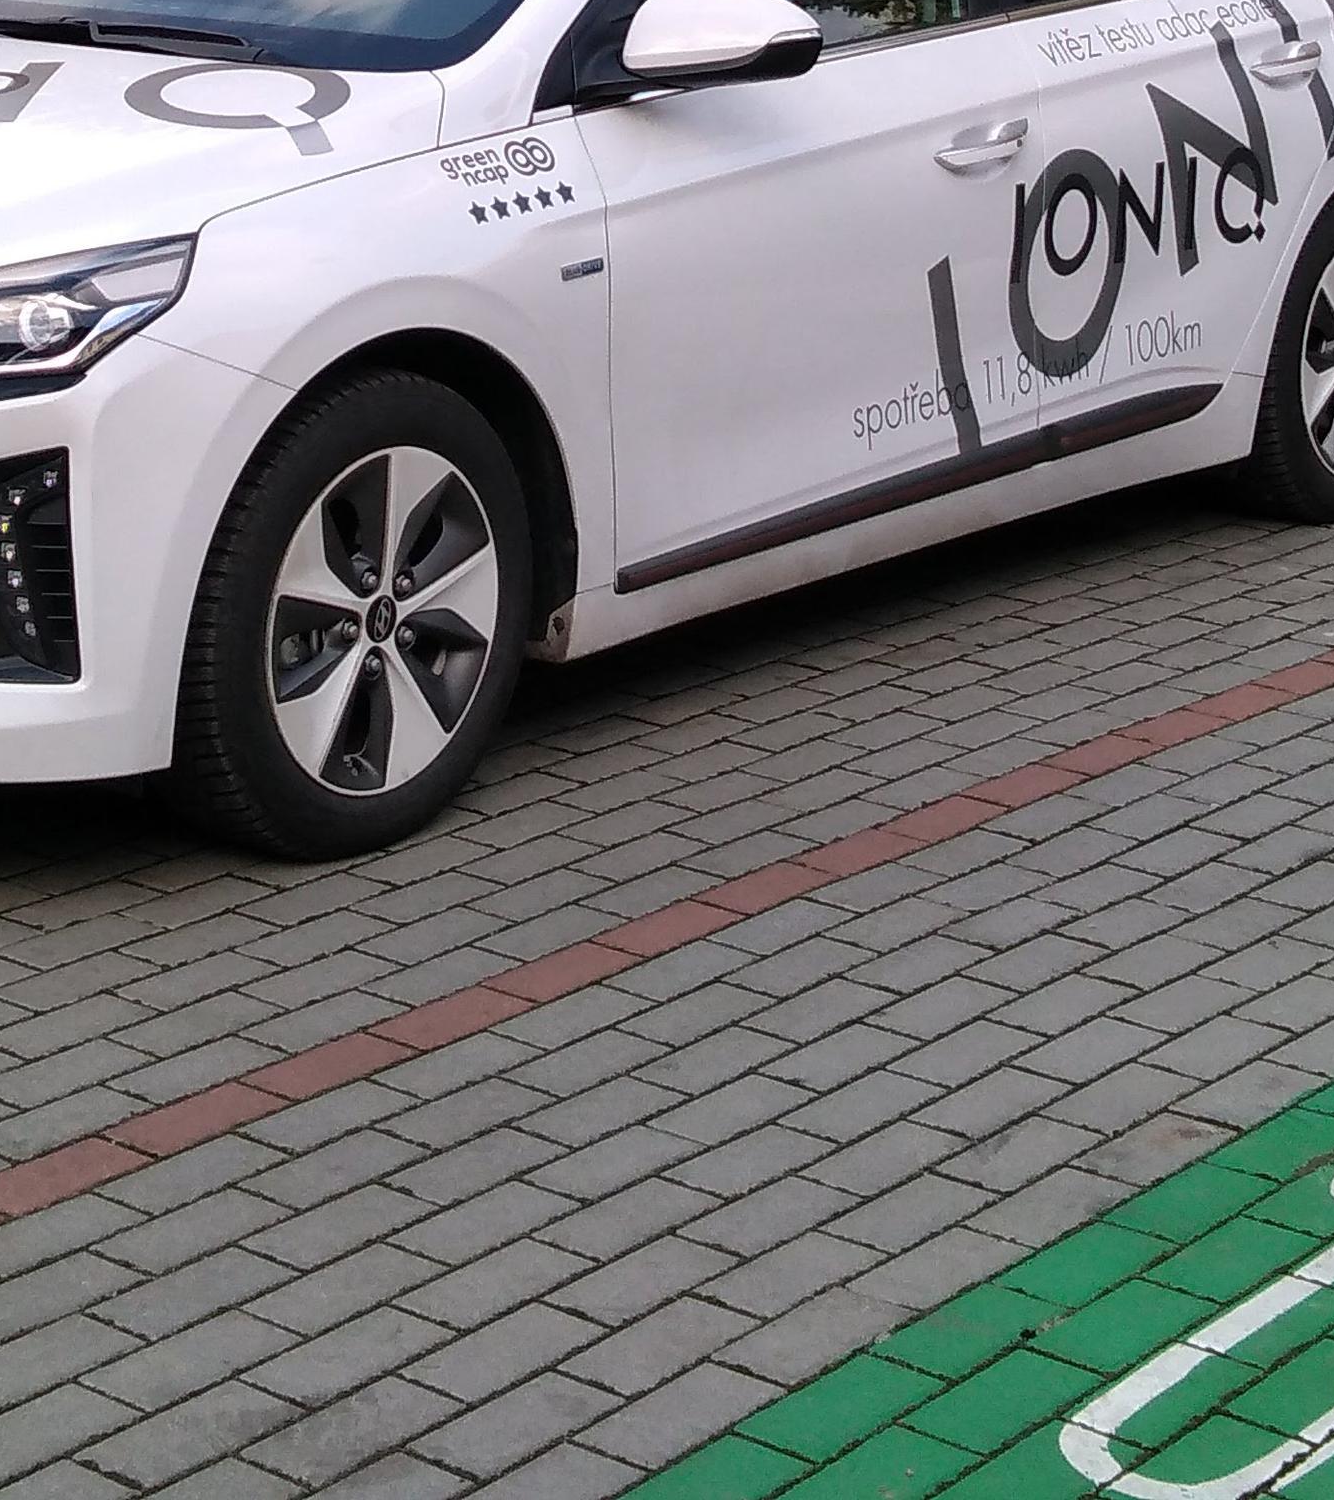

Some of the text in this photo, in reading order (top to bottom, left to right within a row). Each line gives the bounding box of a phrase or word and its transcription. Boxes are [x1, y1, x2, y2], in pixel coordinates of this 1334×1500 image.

[1094, 18, 1156, 54] testu
[1156, 0, 1214, 42] adac
[439, 149, 501, 180] green
[460, 164, 509, 187] ncap
[1009, 147, 1266, 284] IONIQ
[982, 351, 1033, 407] 11,8
[1124, 311, 1202, 366] 100km
